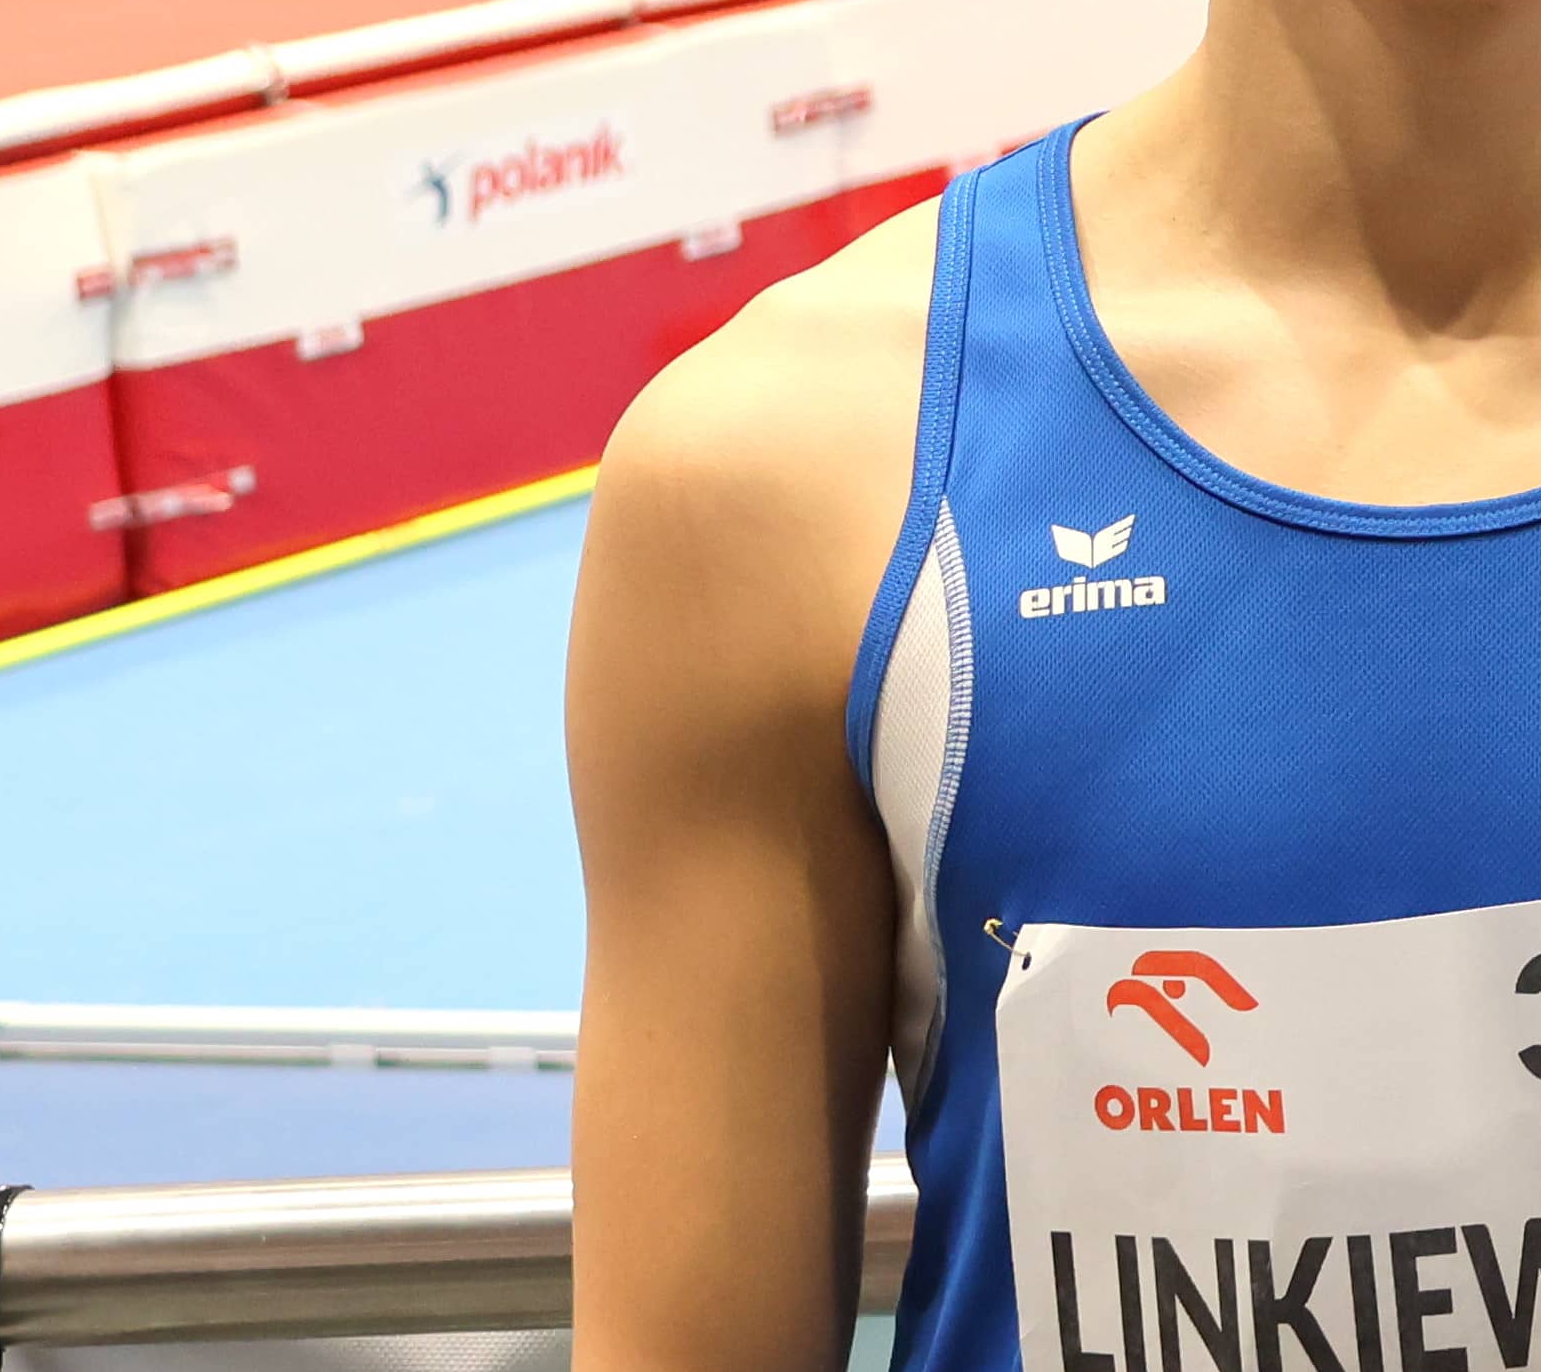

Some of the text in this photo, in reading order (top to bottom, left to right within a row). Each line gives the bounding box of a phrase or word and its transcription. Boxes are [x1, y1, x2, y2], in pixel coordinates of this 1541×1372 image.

[467, 117, 625, 223] polanik
[1019, 575, 1167, 619] erima
[1093, 1084, 1286, 1135] ORLEN
